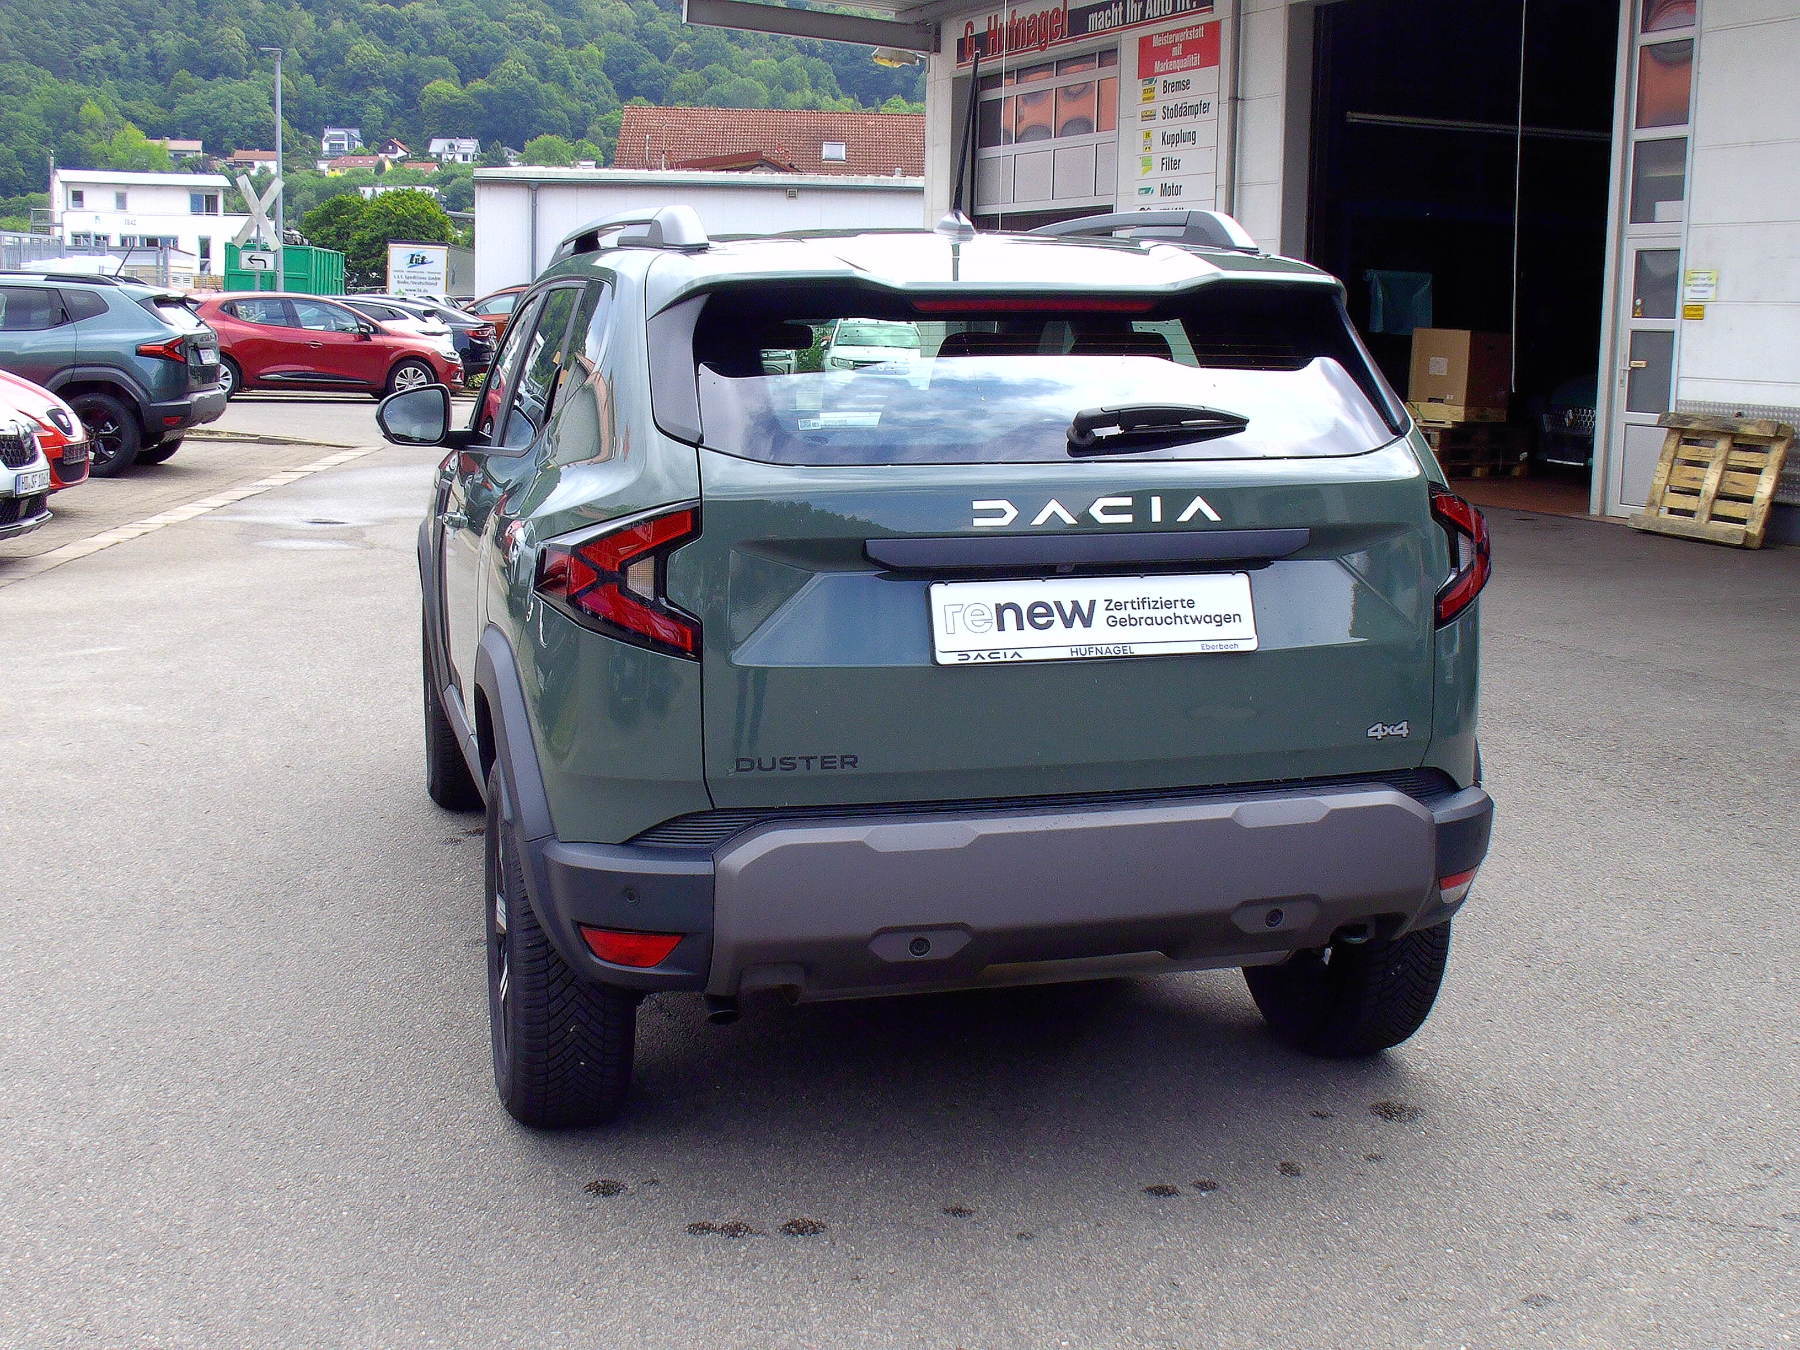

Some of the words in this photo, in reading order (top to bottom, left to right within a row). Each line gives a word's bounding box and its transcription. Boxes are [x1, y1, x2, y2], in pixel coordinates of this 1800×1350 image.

[963, 20, 979, 61] G
[987, 0, 1069, 54] Hufnagel
[1088, 2, 1124, 32] macht
[1125, 0, 1142, 24] Ihr
[1145, 0, 1174, 20] Auto
[1152, 25, 1205, 48] Meisterwerkstatt
[1171, 43, 1183, 57] mit
[1154, 53, 1201, 74] Markenqualität
[1162, 79, 1191, 95] Bremse
[1161, 100, 1211, 120] Stoßdämpfer
[1161, 129, 1197, 148] Kupplung
[1160, 156, 1182, 171] Filter
[1160, 182, 1183, 198] Motor
[972, 496, 1222, 527] DACIA
[1103, 597, 1196, 612] Zertifizierte
[943, 599, 1096, 635] renew
[1105, 612, 1242, 628] Gebrauchtwagen
[957, 651, 1023, 662] DACIA
[1070, 645, 1135, 657] HUFNAGEL
[1367, 721, 1409, 740] 4x4
[735, 754, 859, 772] DUSTER
